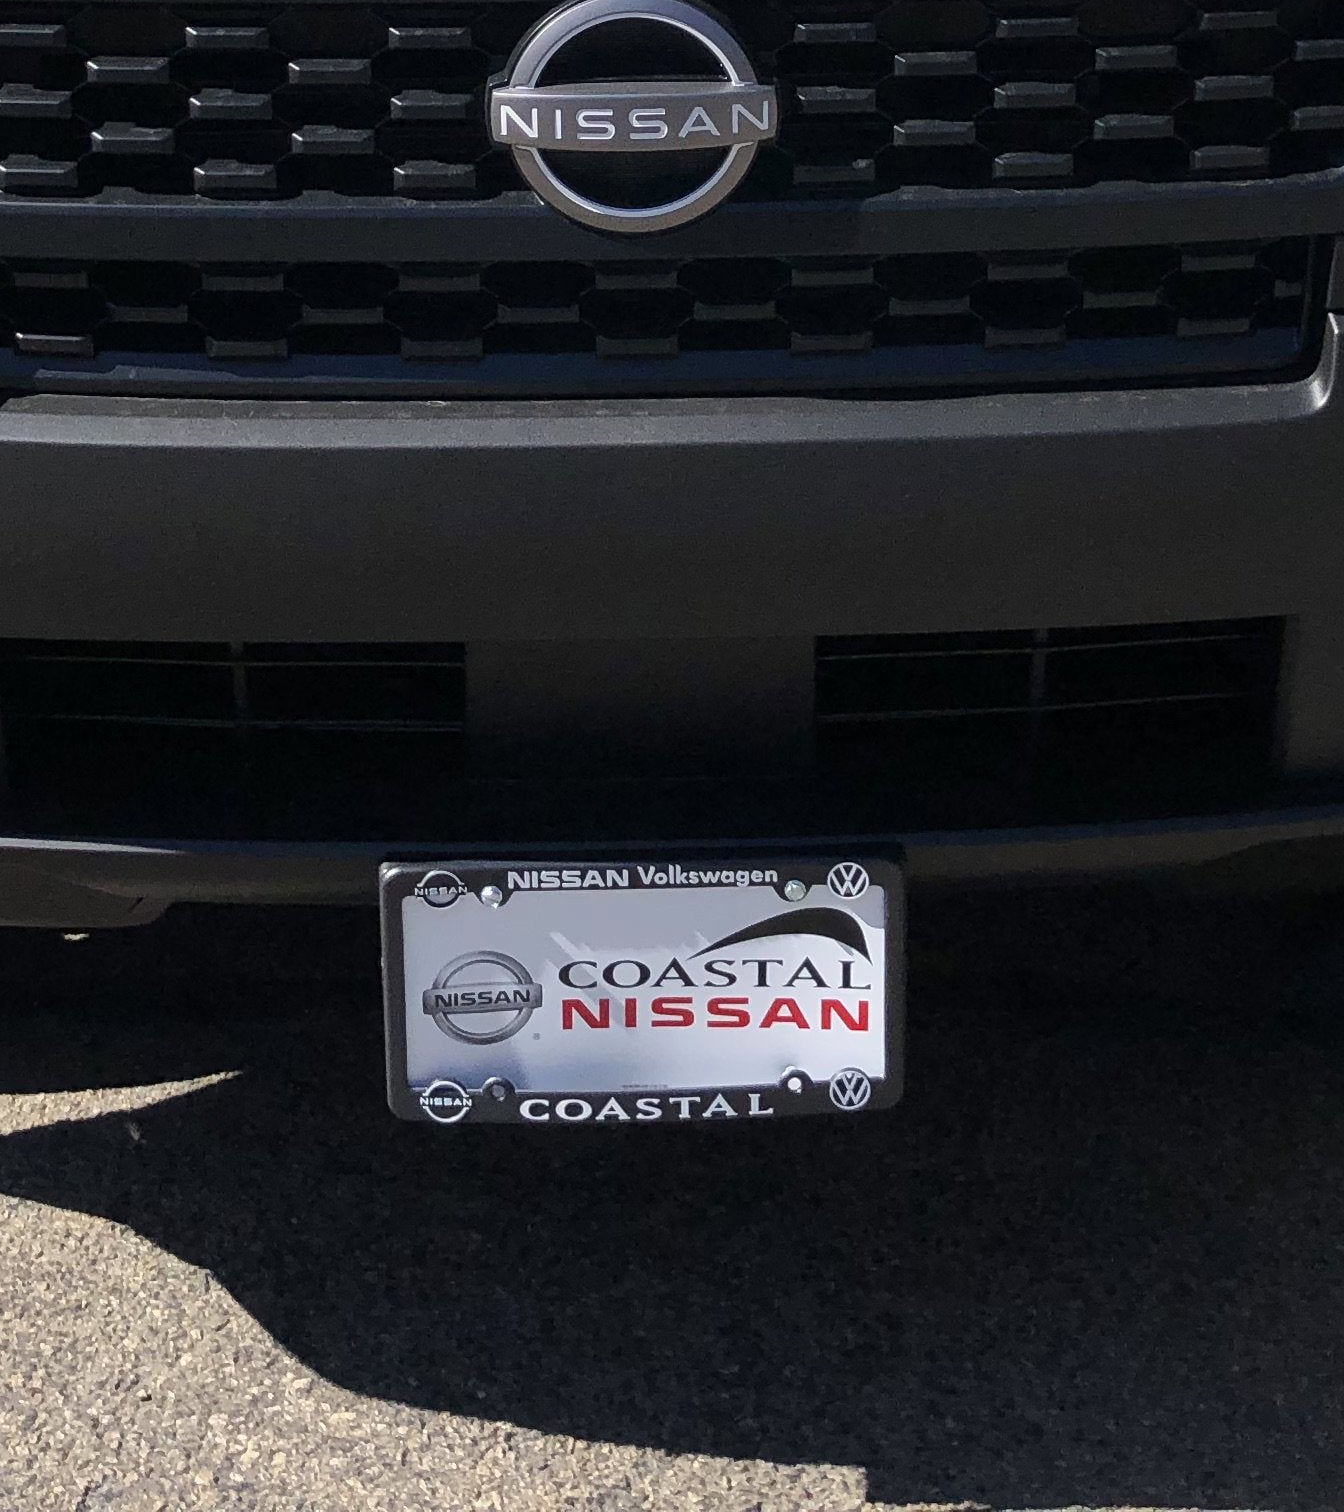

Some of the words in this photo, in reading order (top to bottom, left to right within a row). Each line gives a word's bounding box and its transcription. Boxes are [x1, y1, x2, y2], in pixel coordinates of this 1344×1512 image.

[500, 100, 769, 140] NISSAN
[507, 868, 630, 889] NISSAN
[637, 865, 778, 886] Volkswagen
[414, 886, 468, 896] NISSAN
[558, 956, 872, 990] COASTAL
[433, 987, 531, 1009] NISSAN
[561, 996, 869, 1032] NISSAN
[419, 1096, 473, 1107] NISSAN
[519, 1092, 774, 1122] COASTAL
